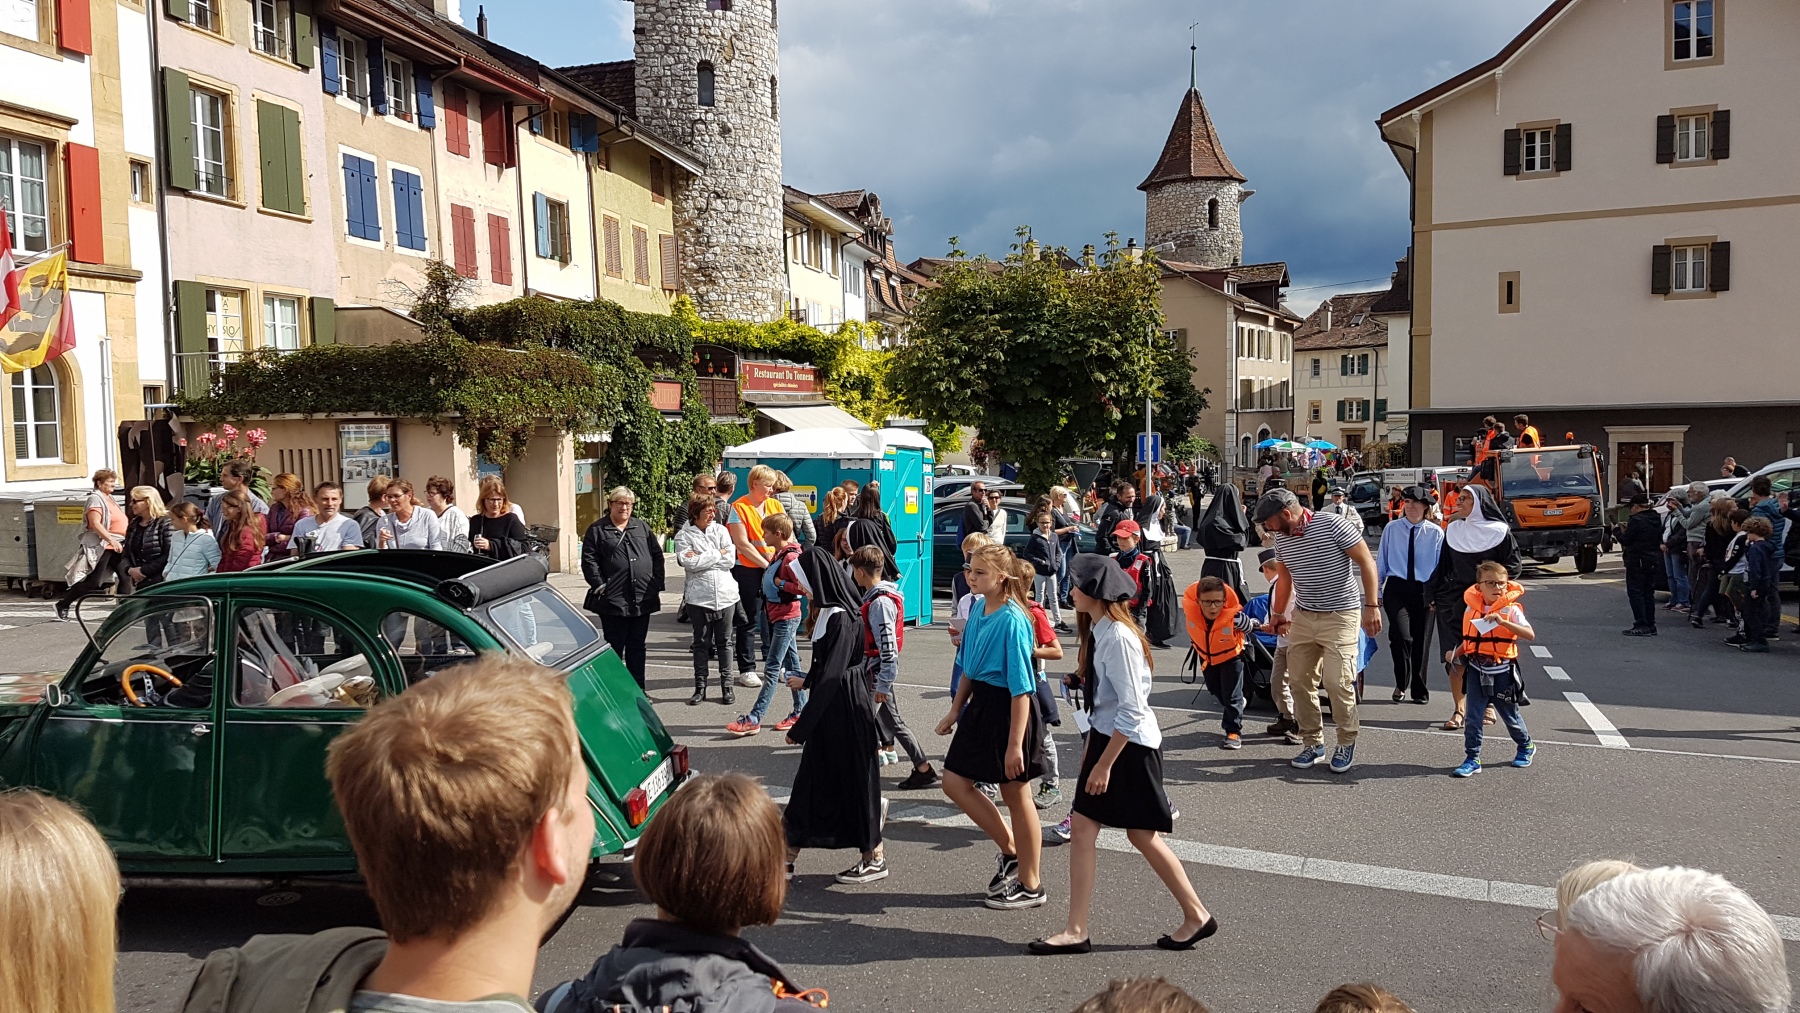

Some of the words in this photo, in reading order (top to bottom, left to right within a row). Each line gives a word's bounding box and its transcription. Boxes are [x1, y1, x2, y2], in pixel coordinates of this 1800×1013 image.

[753, 367, 785, 380] Restaurant
[785, 370, 793, 380] Du
[793, 371, 814, 381] Tonneau
[878, 622, 897, 664] KLEIN
